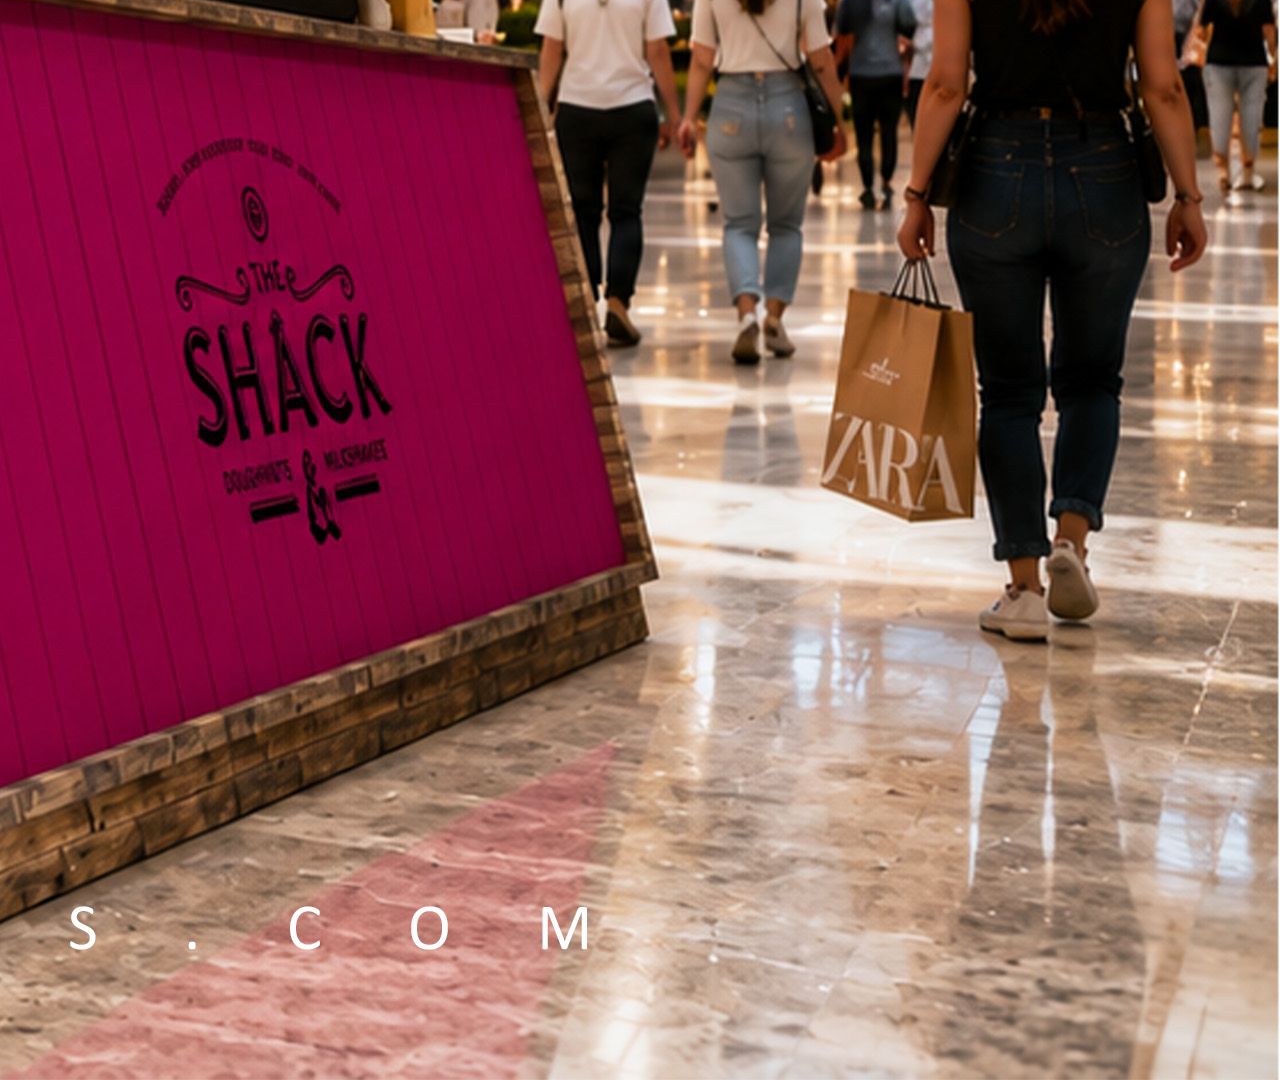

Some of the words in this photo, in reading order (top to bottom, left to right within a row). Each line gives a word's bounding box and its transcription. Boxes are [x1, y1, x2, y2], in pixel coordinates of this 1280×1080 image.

[248, 260, 287, 294] THE
[184, 309, 393, 448] SHACK
[821, 411, 966, 515] ZARA
